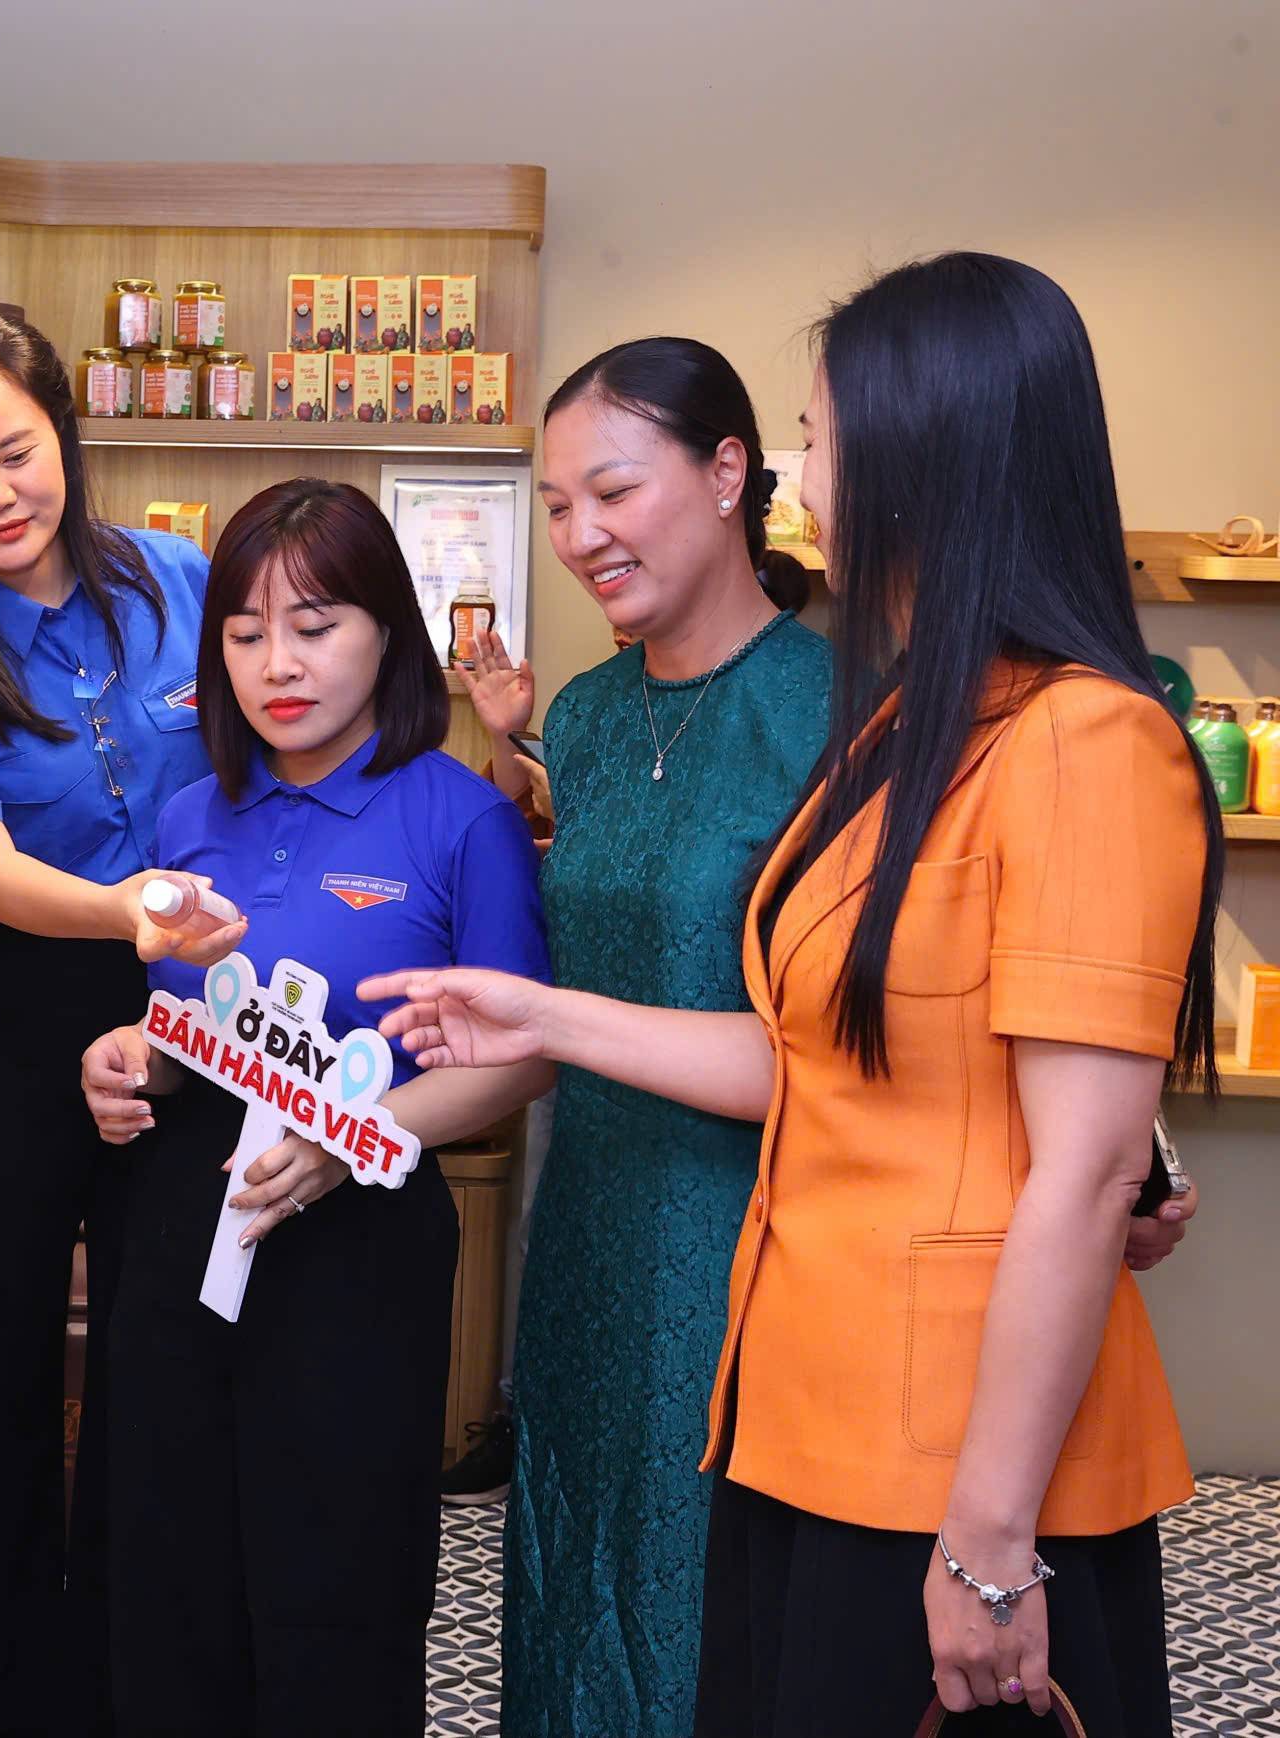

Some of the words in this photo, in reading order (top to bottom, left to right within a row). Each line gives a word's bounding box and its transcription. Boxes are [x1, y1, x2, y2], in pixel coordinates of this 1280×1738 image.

[351, 880, 367, 888] NIÊN
[368, 882, 383, 891] VIỆT
[384, 886, 401, 894] NAM
[236, 998, 265, 1043] Ở
[264, 1021, 336, 1085] ĐÂY
[147, 1002, 218, 1068] BÁN
[218, 1043, 317, 1128] HÀNG
[323, 1102, 404, 1174] VIỆT
